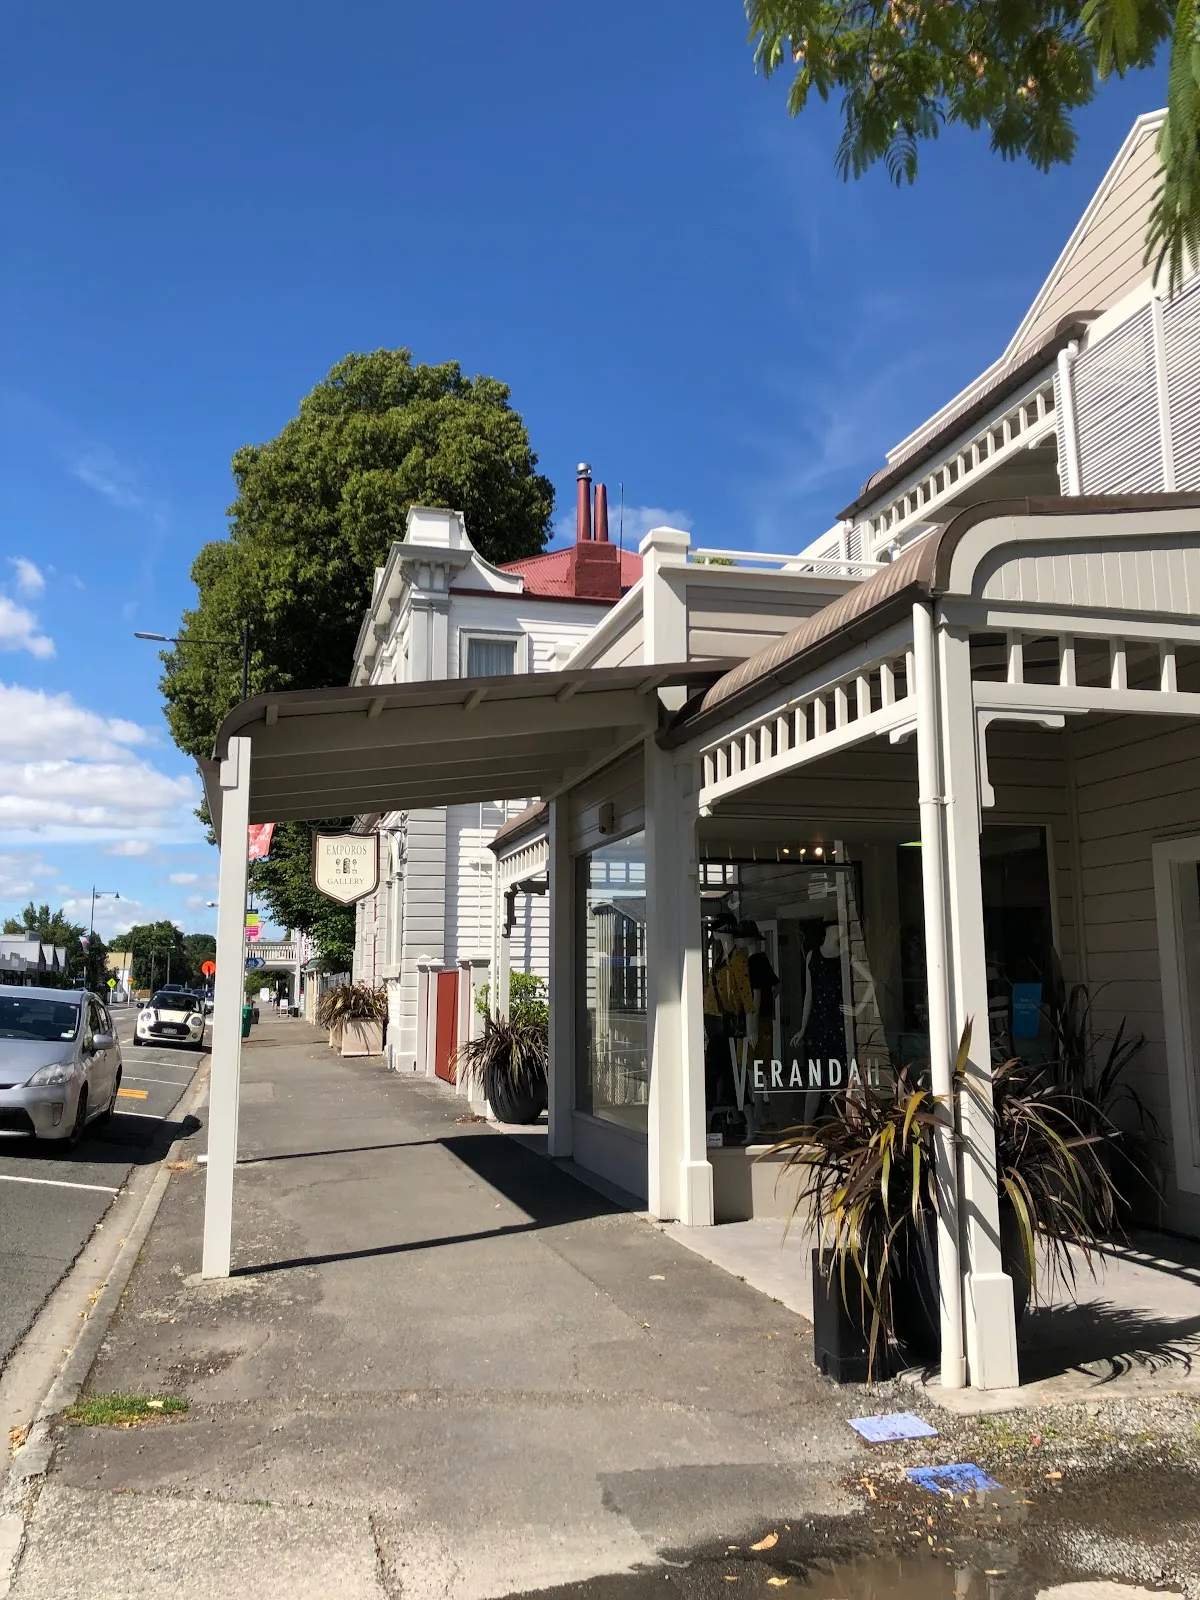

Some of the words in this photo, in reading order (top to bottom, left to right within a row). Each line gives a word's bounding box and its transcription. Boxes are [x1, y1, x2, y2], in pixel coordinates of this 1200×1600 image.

[326, 844, 367, 856] EMPOROS
[327, 877, 365, 885] GALLERY
[728, 1037, 880, 1111] VERANDAH
